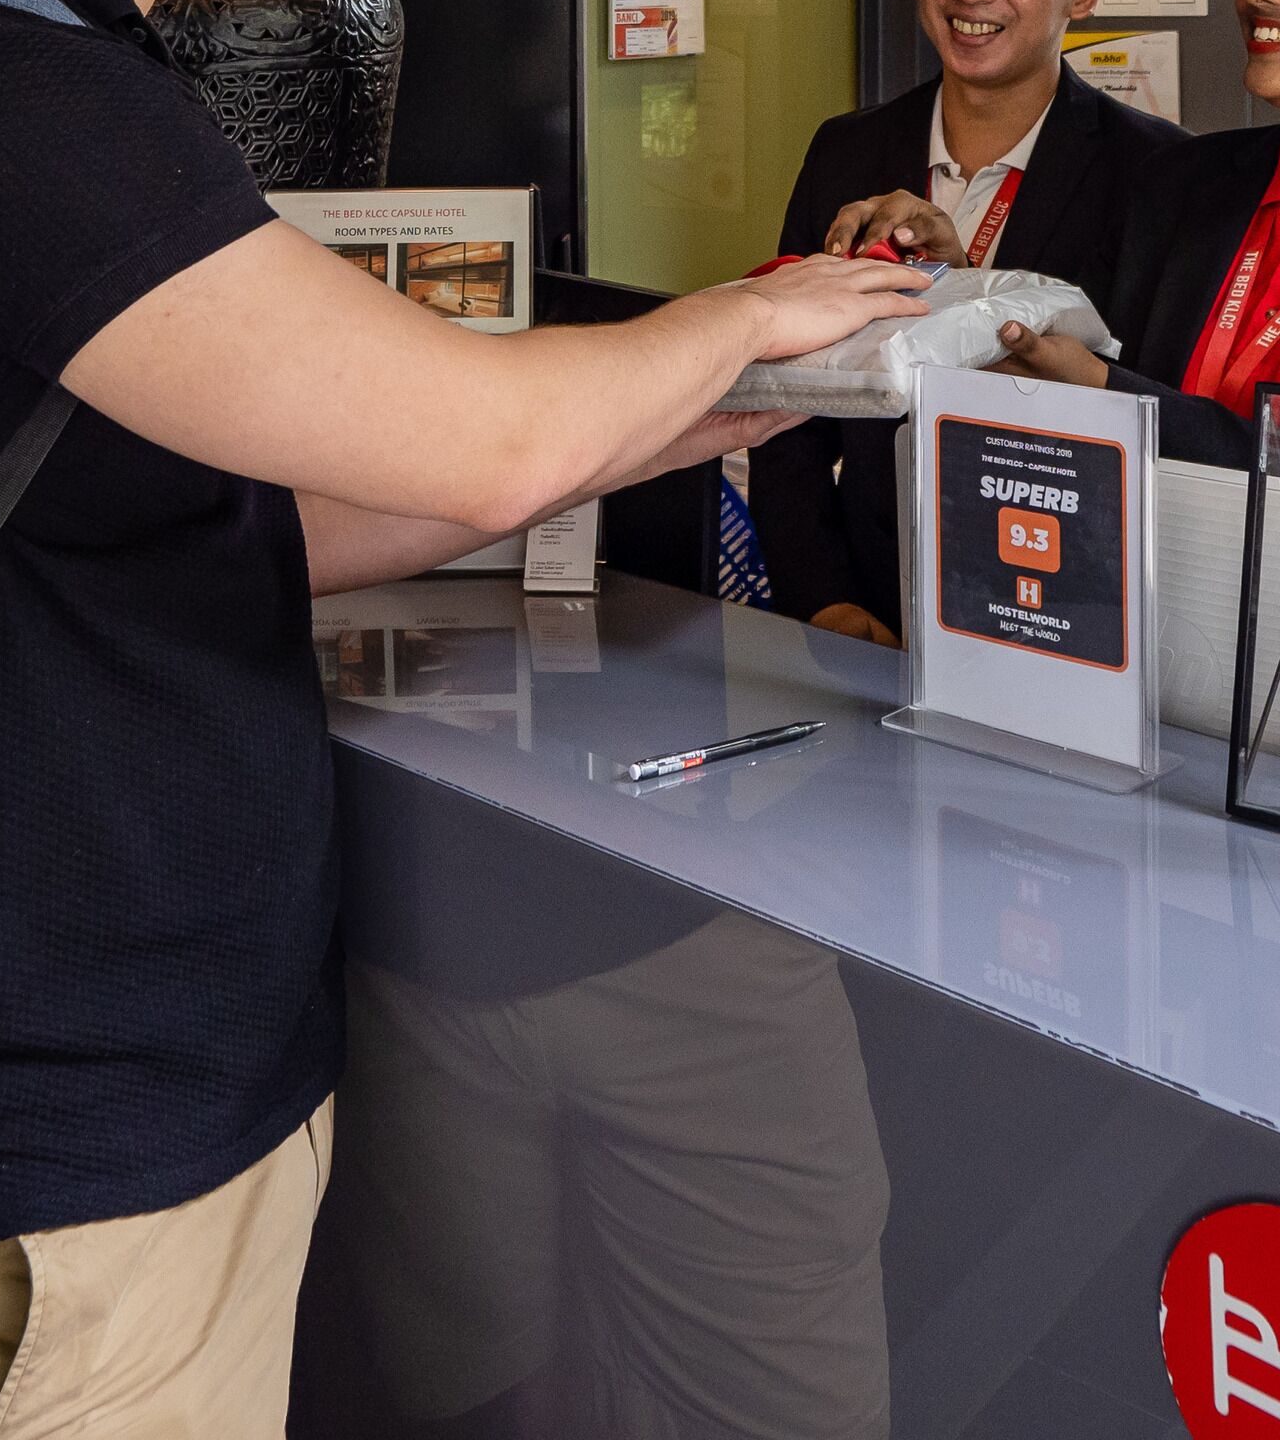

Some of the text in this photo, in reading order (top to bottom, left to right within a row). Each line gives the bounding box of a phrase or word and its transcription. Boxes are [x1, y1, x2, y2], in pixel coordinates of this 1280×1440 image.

[323, 208, 467, 219] THE BED KLCC CAPSULE HOTEL
[976, 226, 995, 248] BED
[986, 200, 1009, 226] KLCC
[335, 226, 454, 237] ROOM TYPES AND RATES
[1219, 250, 1260, 330] THE BED KLCC
[985, 436, 1073, 459] CUSTOMER RATINGS 2019
[1028, 462, 1056, 473] CAPSULE
[979, 474, 1080, 514] SUPERB
[1009, 523, 1049, 553] 9.3
[988, 602, 1071, 631] HOSTELWORLD
[999, 620, 1061, 643] MEET THE WORLD
